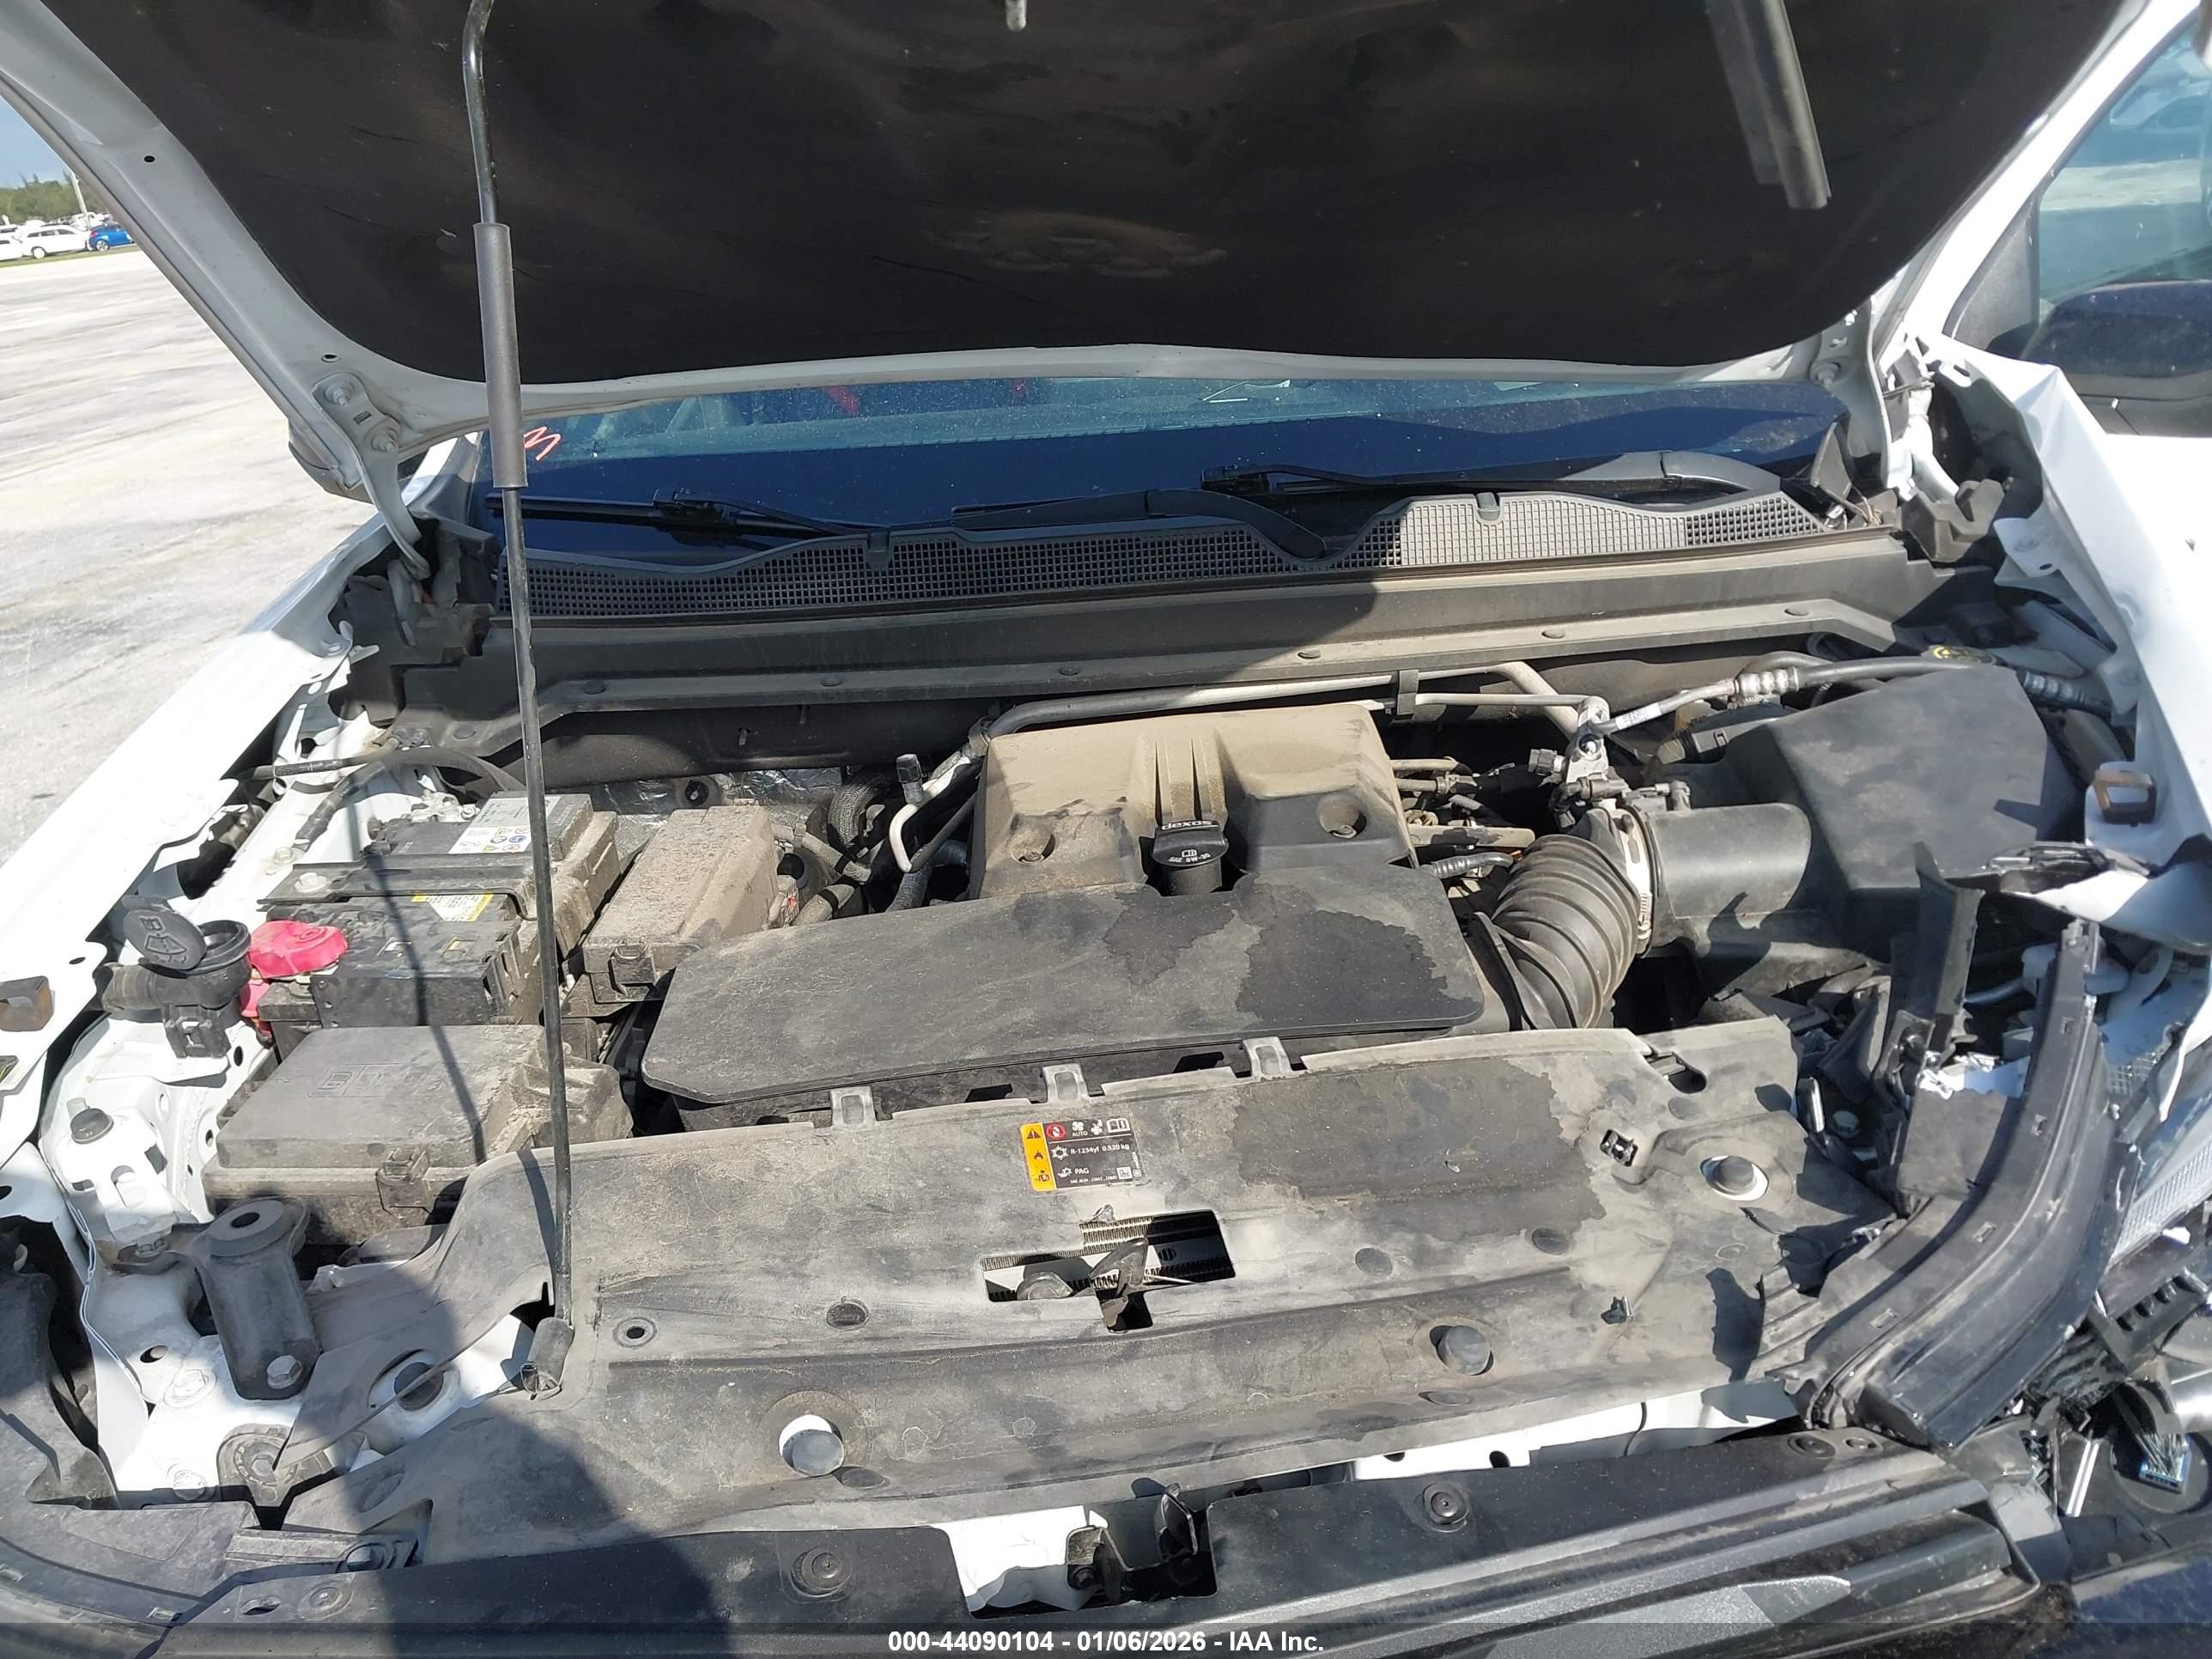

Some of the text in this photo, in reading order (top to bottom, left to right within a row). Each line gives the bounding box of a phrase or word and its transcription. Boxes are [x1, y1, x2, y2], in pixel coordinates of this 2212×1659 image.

[1162, 820, 1212, 830] dexos
[1070, 1142, 1130, 1155] R-1234yf 0.520 kg
